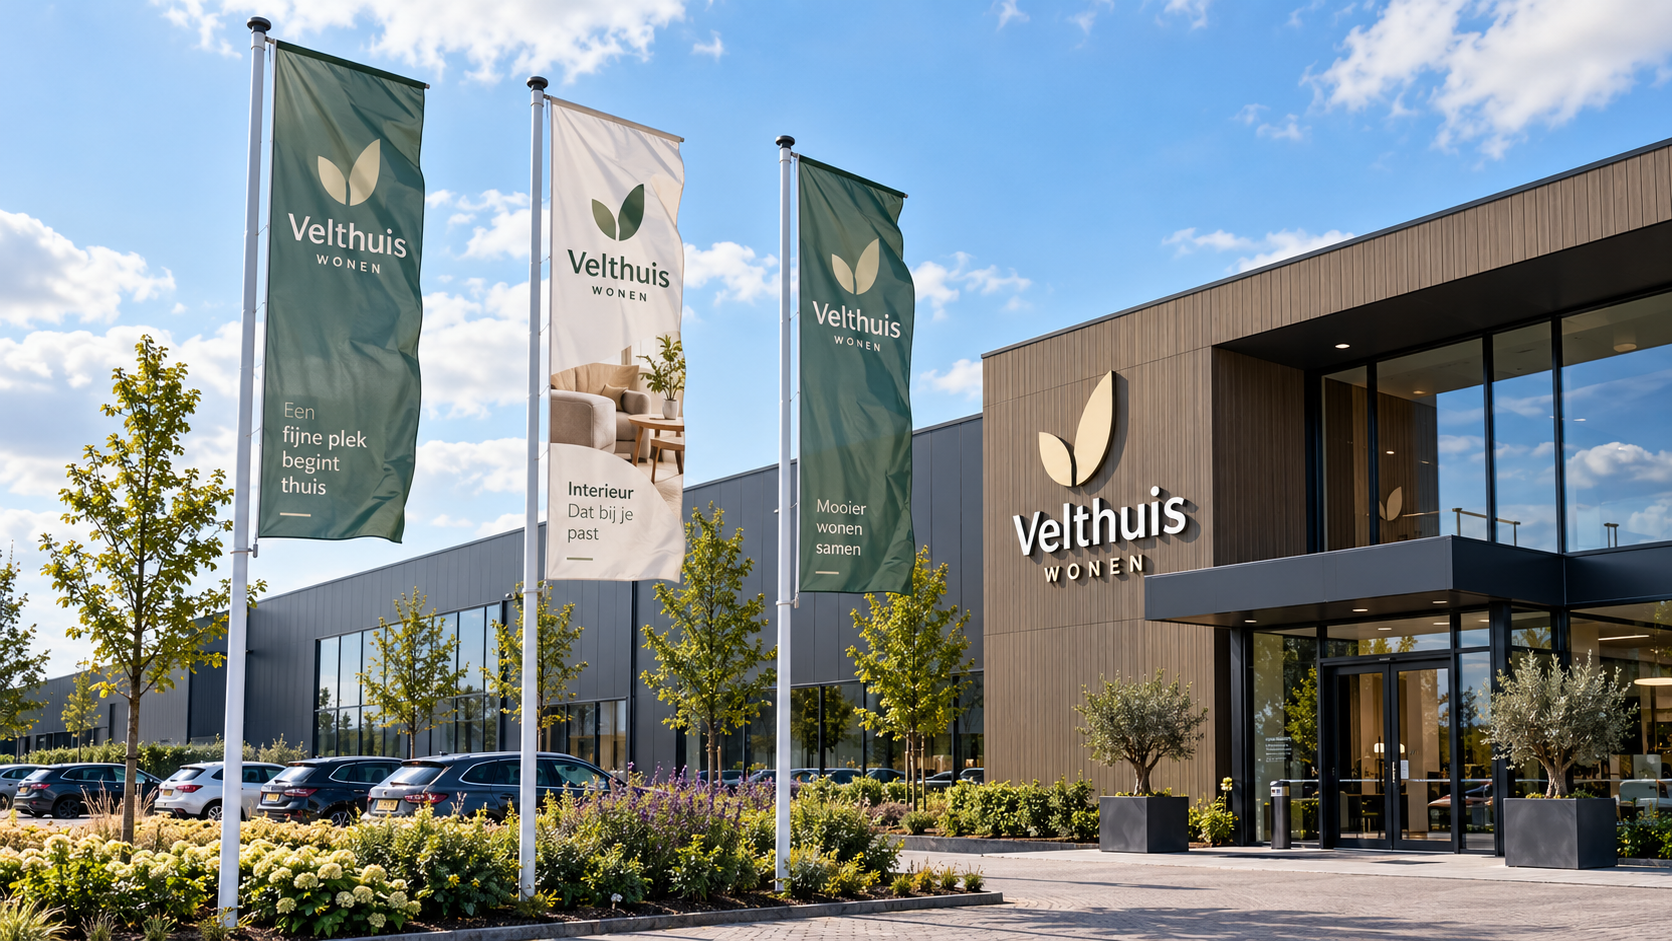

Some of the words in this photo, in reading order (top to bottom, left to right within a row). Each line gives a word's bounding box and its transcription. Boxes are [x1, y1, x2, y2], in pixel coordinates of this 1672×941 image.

[288, 212, 407, 259] Velthuis
[316, 253, 382, 275] WONEN
[567, 248, 670, 289] Velthuis
[591, 285, 648, 303] WONEN
[812, 300, 902, 340] Velthuis
[834, 335, 882, 353] WONEN
[284, 401, 316, 420] Een
[282, 425, 323, 449] fijne
[328, 430, 368, 451] plek
[282, 451, 341, 475] begint
[281, 476, 327, 496] thuis
[568, 481, 634, 500] Interieur
[568, 503, 595, 519] Dat
[599, 504, 617, 525] bij
[619, 508, 634, 525] je
[816, 498, 867, 516] Mooier
[816, 522, 863, 536] wonen
[1012, 485, 1188, 557] Velthuis
[567, 526, 600, 543] past
[816, 542, 862, 557] samen
[1044, 554, 1144, 583] WONEN
